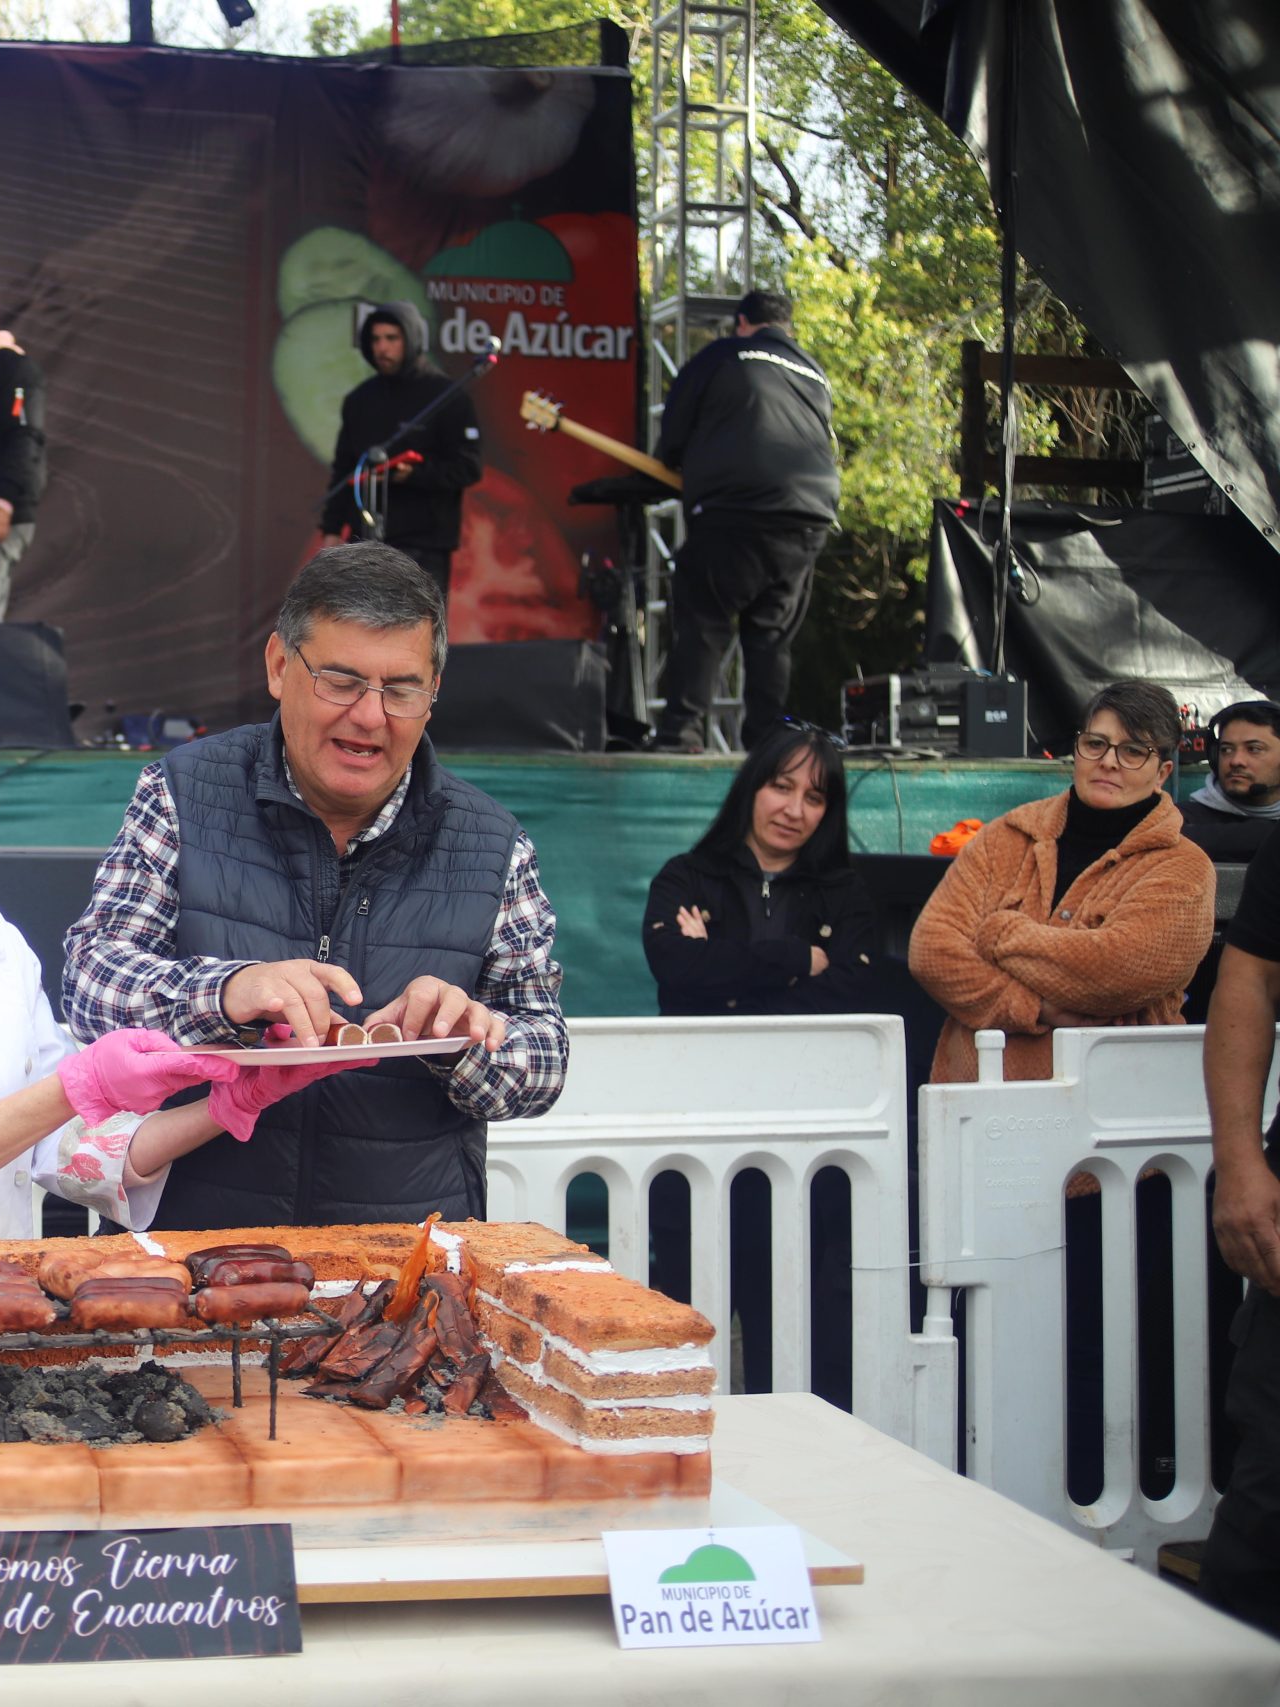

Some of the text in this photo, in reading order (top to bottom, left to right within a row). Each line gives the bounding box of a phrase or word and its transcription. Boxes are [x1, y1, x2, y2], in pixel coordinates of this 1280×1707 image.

[427, 281, 565, 306] MUNICIPIO DE
[441, 306, 491, 354] de
[502, 310, 633, 360] Azúcar
[102, 1536, 238, 1590] Tierra
[3, 1586, 286, 1637] de Encuentros
[661, 1585, 752, 1601] MUNICIPIO DE
[621, 1599, 810, 1634] Pan de Azúcar
